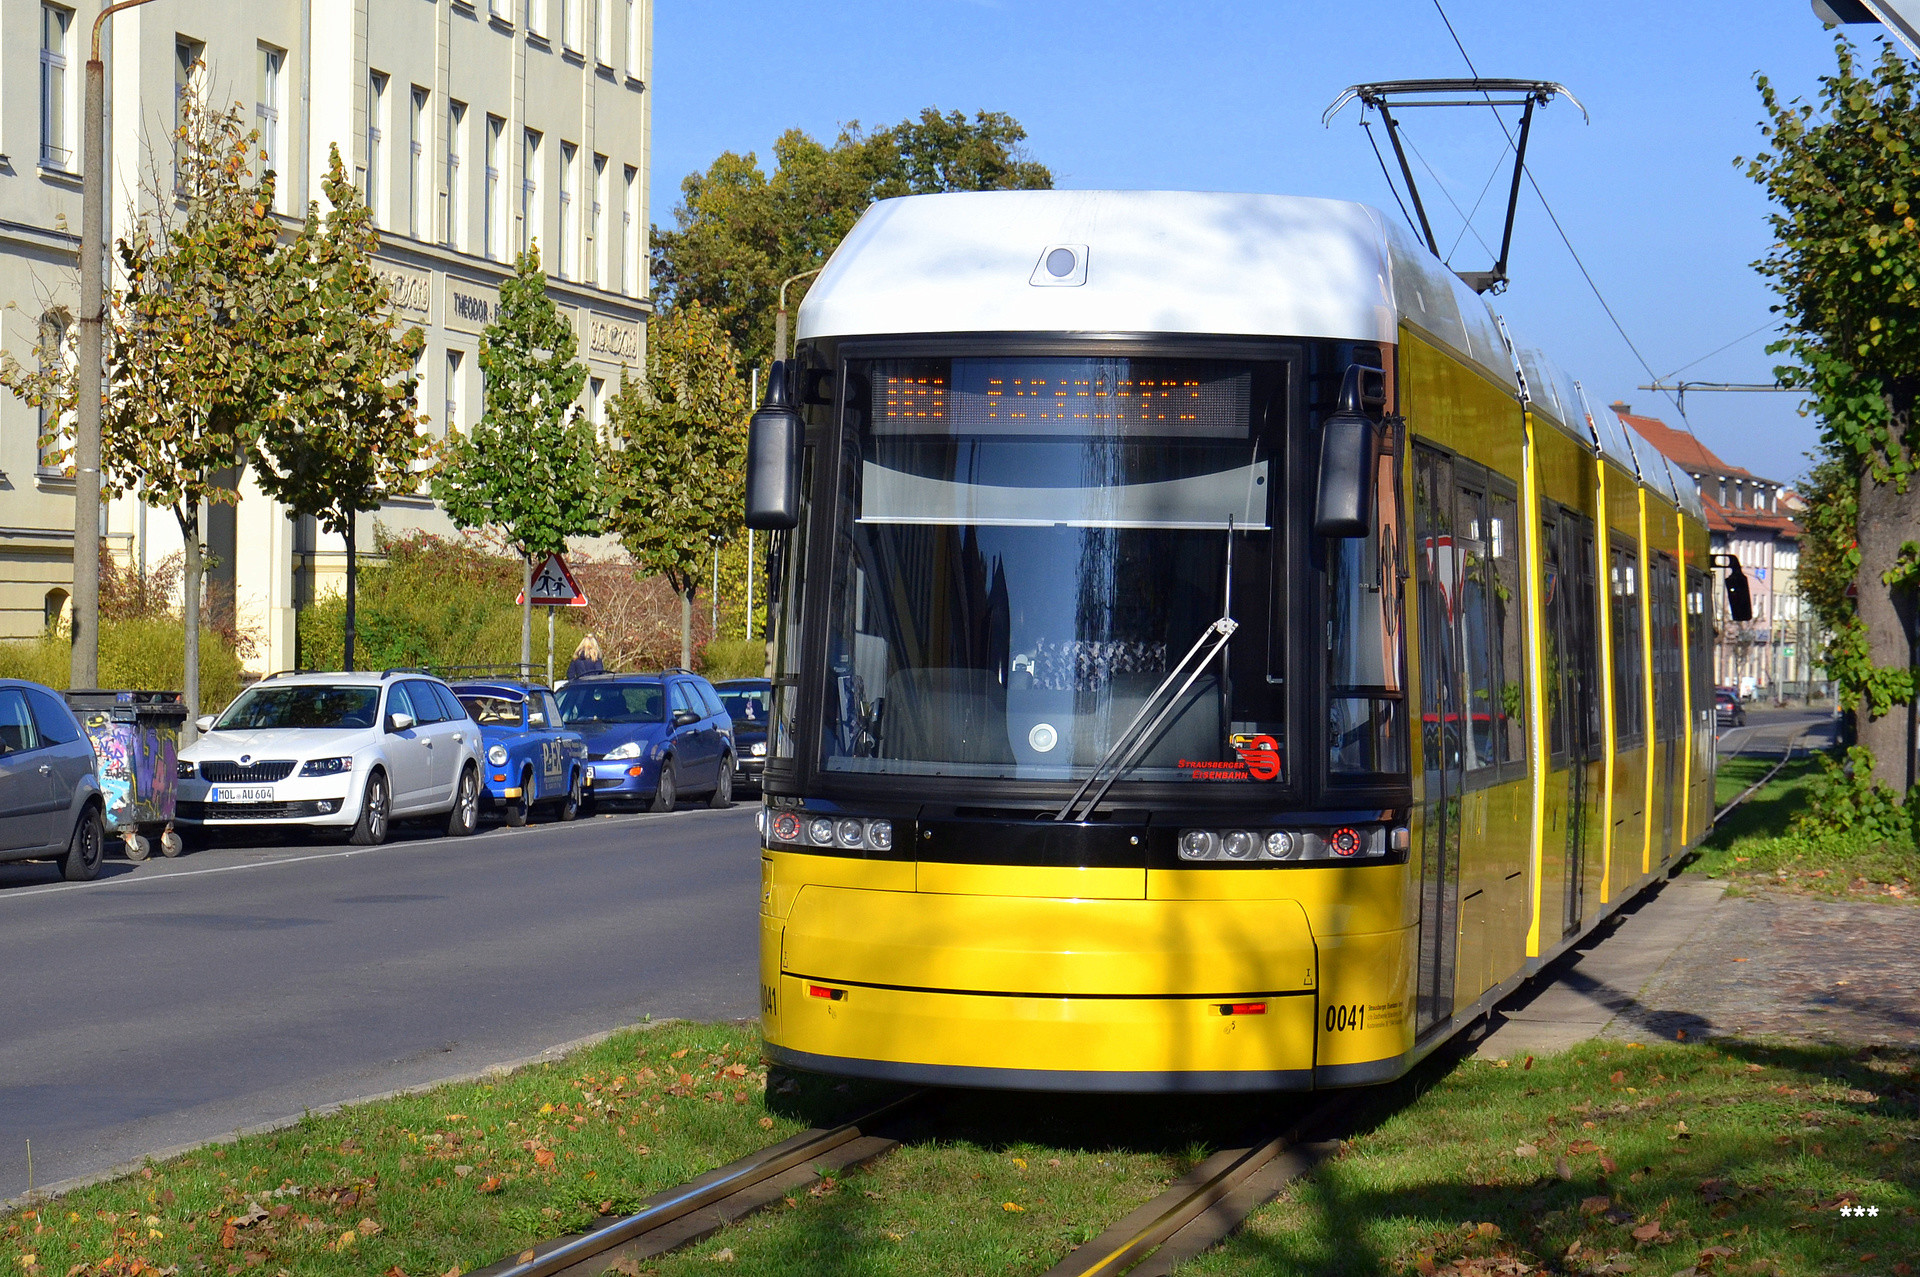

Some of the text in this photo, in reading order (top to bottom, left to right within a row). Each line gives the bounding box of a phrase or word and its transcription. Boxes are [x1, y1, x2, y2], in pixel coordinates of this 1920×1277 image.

[453, 292, 488, 324] THEODOR
[1177, 759, 1245, 769] STRAUSBERGER
[1192, 769, 1249, 780] EISENBAHN
[218, 789, 272, 800] MOL AU 604
[1325, 1004, 1365, 1033] 0041
